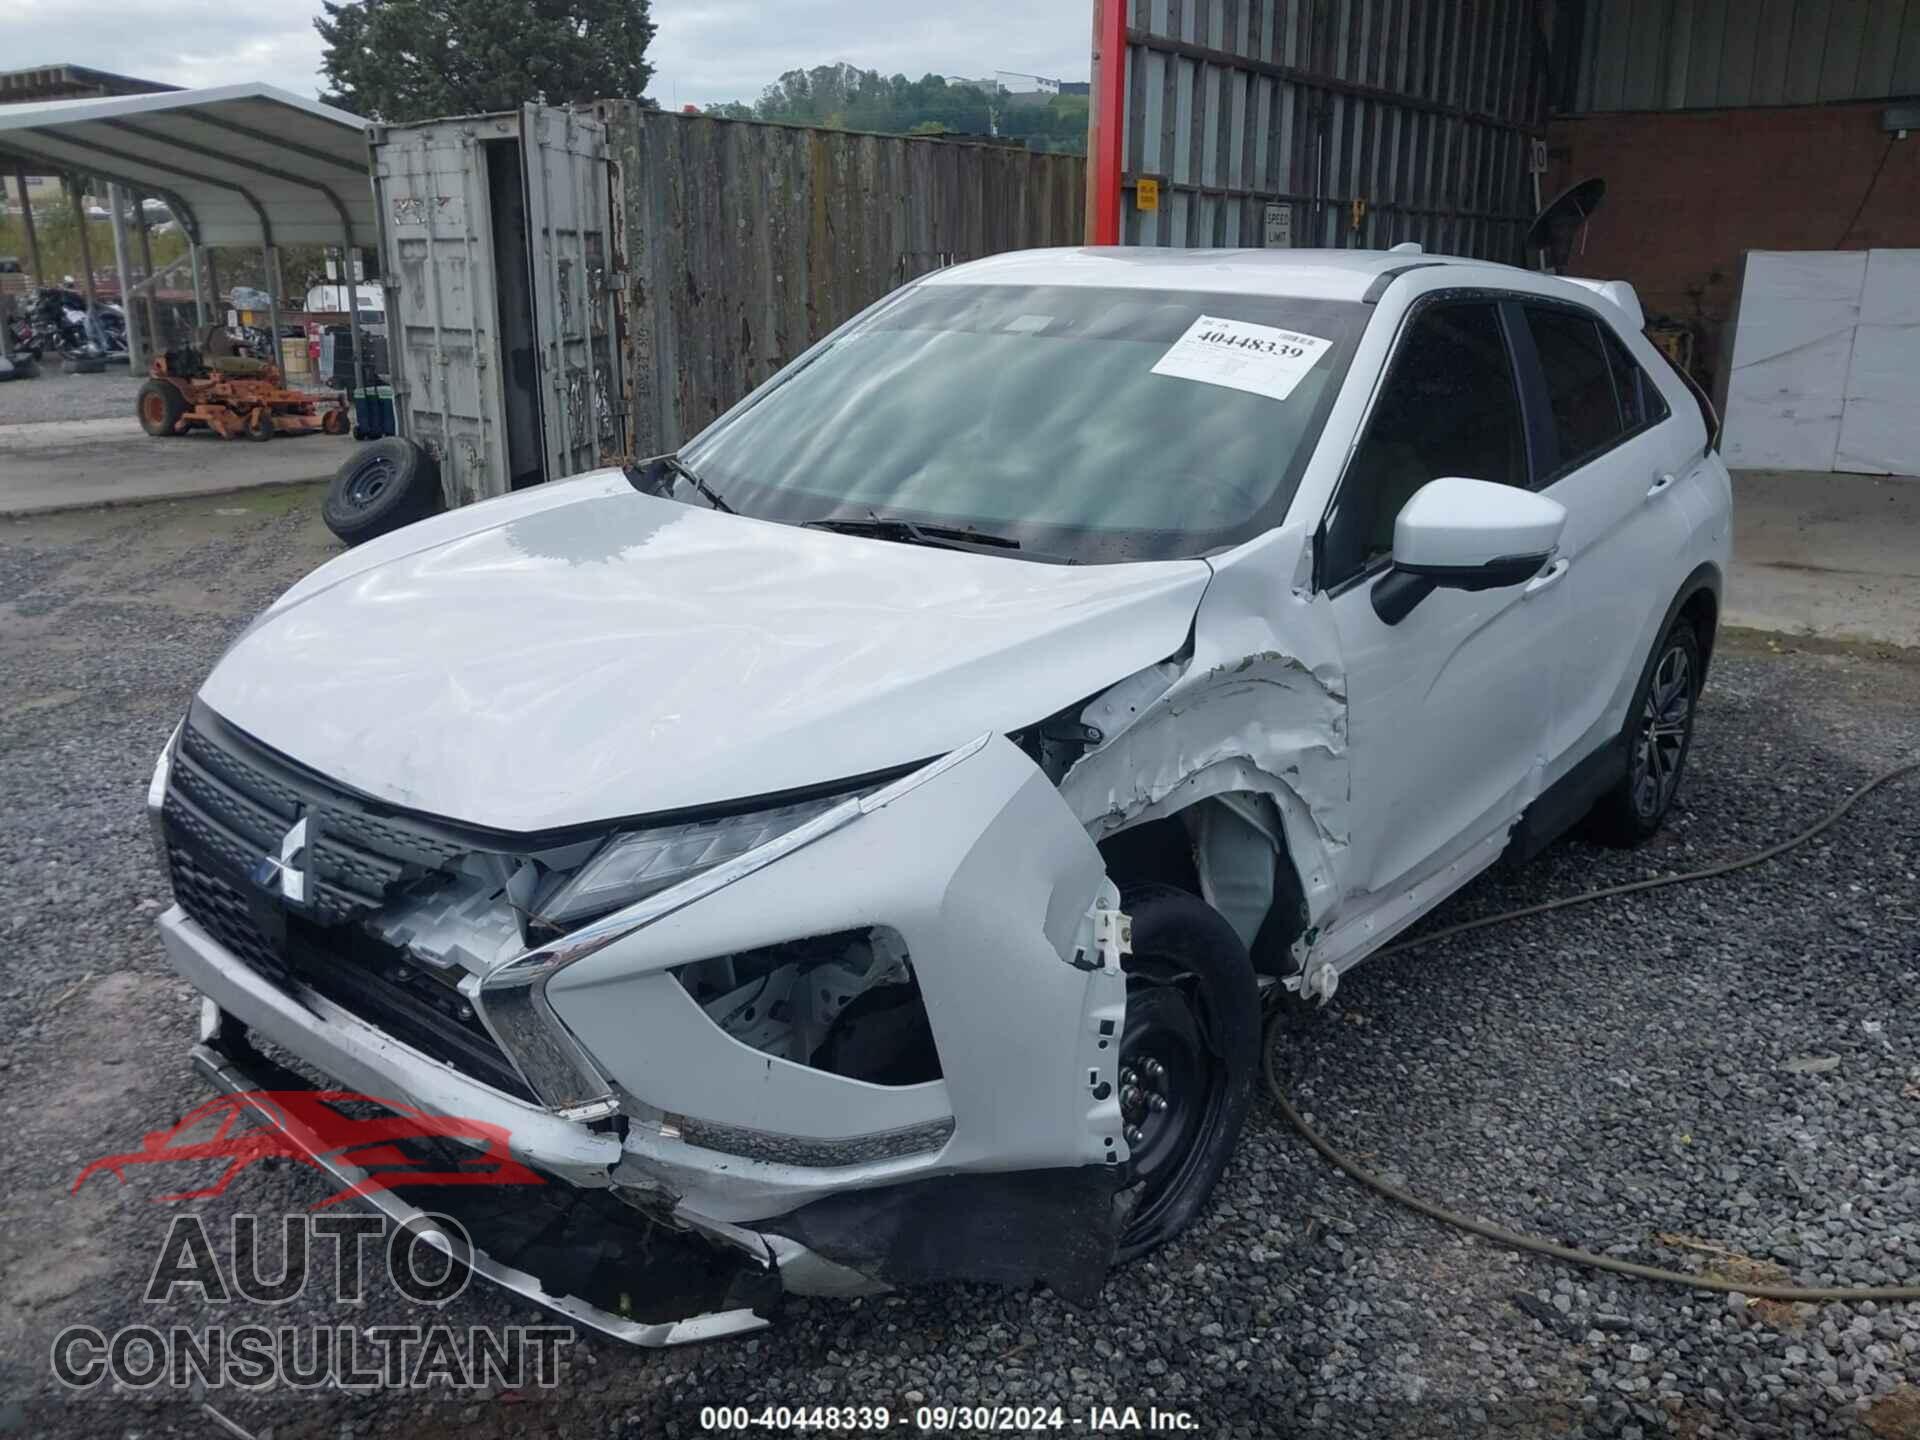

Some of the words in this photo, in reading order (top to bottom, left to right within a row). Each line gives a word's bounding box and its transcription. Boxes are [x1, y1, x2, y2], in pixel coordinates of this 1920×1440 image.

[1267, 213, 1288, 225] SPEED
[1268, 231, 1286, 242] LIMIT
[1198, 331, 1304, 358] 40448339
